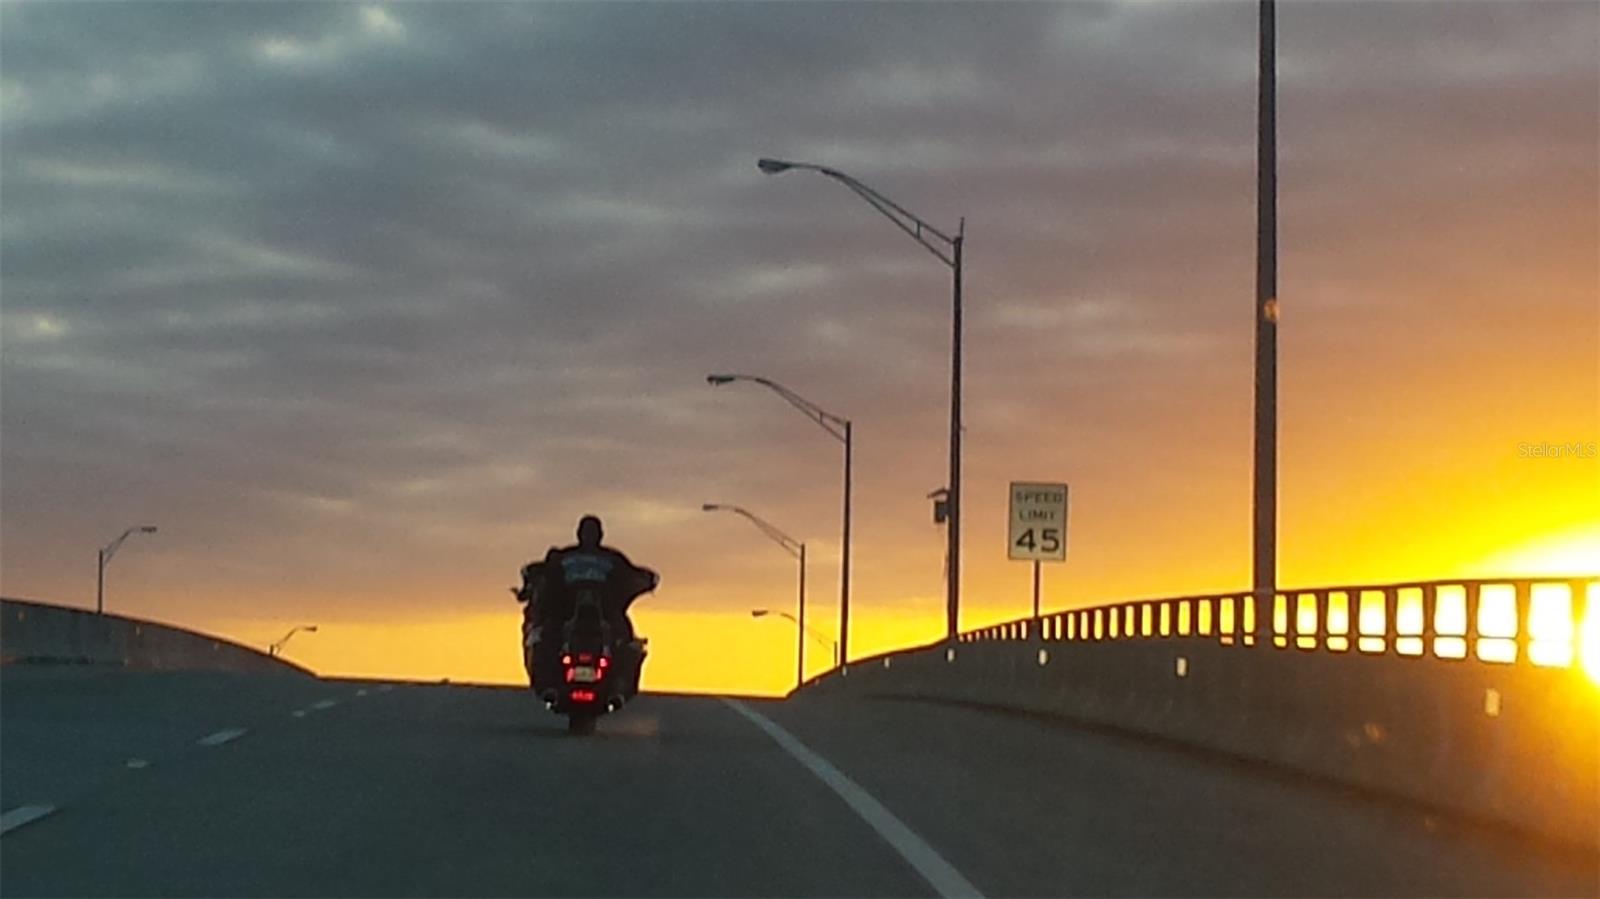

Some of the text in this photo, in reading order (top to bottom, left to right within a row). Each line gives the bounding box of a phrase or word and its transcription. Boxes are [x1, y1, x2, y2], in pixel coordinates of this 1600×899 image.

[1016, 491, 1063, 503] SPEED
[1018, 509, 1056, 520] LIMIT
[1016, 528, 1060, 552] 45
